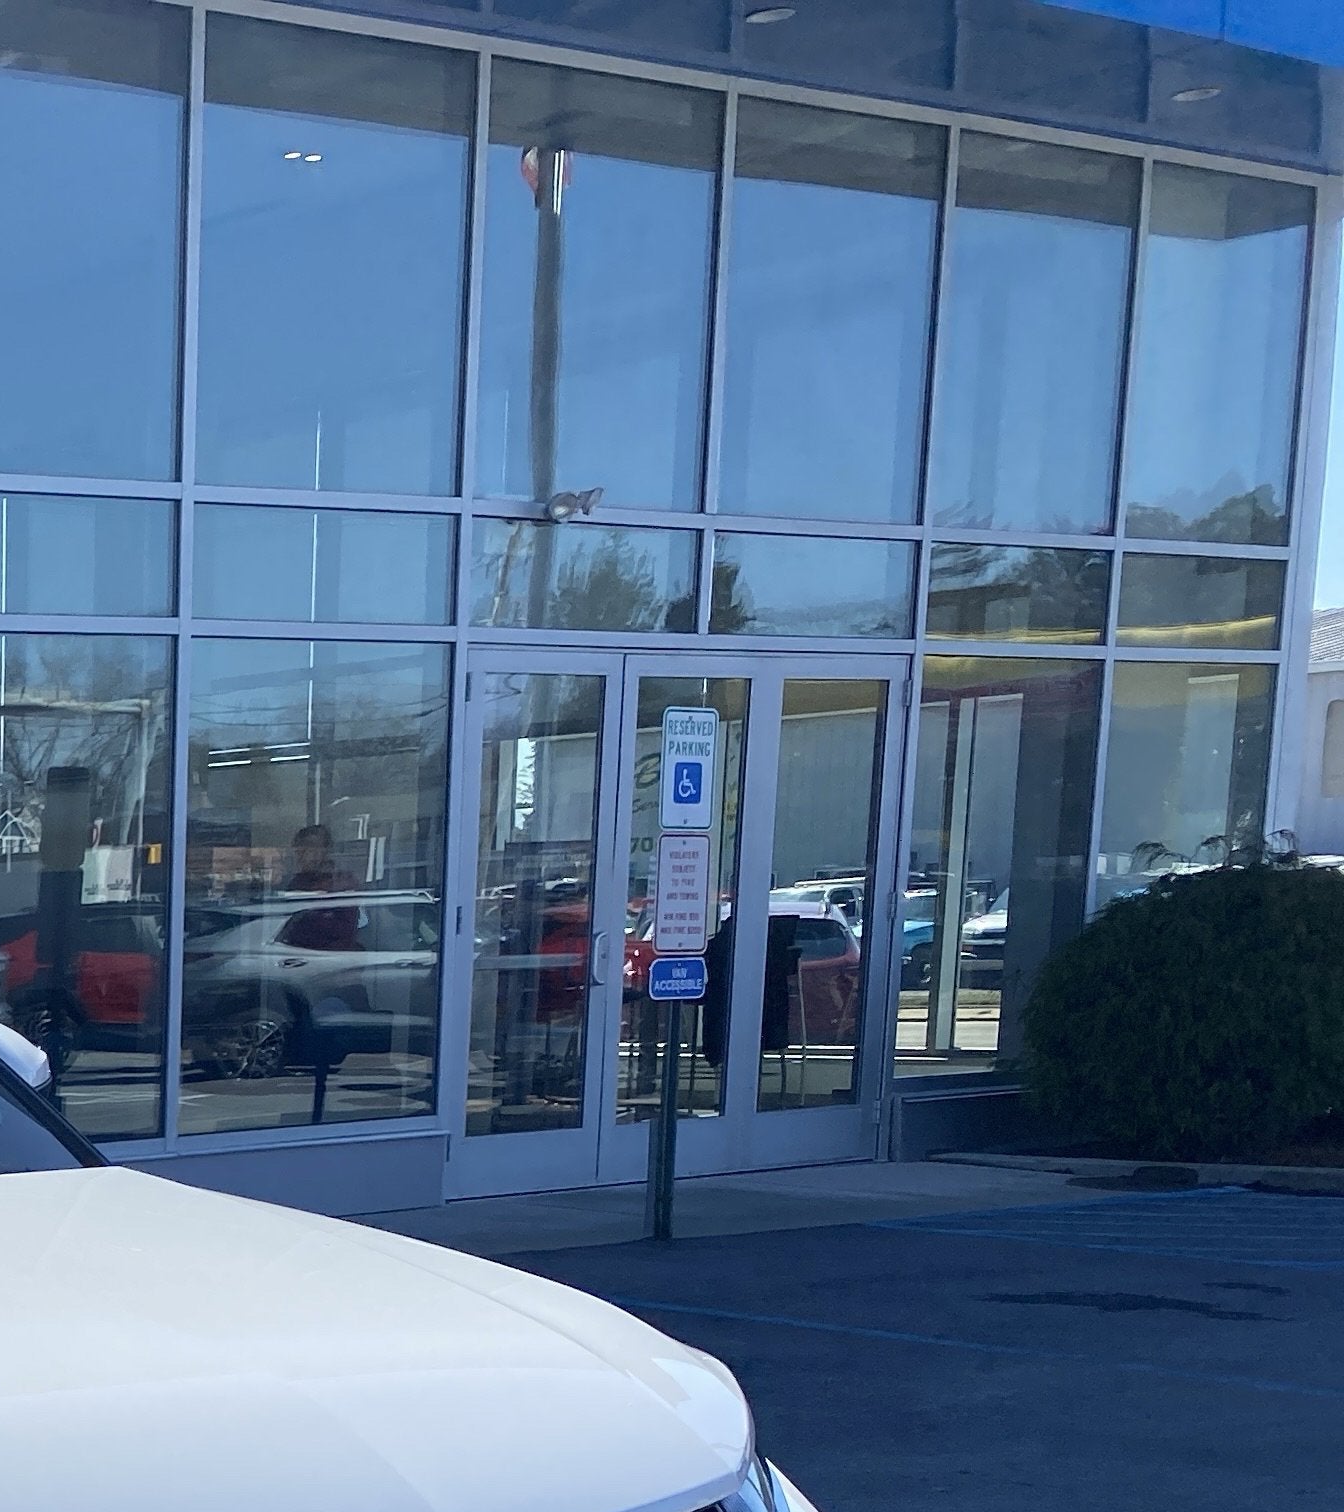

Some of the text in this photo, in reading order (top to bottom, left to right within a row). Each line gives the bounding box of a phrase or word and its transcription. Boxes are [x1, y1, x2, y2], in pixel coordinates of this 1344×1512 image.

[668, 719, 713, 737] RESERVED
[668, 740, 711, 757] PARKING
[654, 978, 704, 992] ACCESSIBLE
